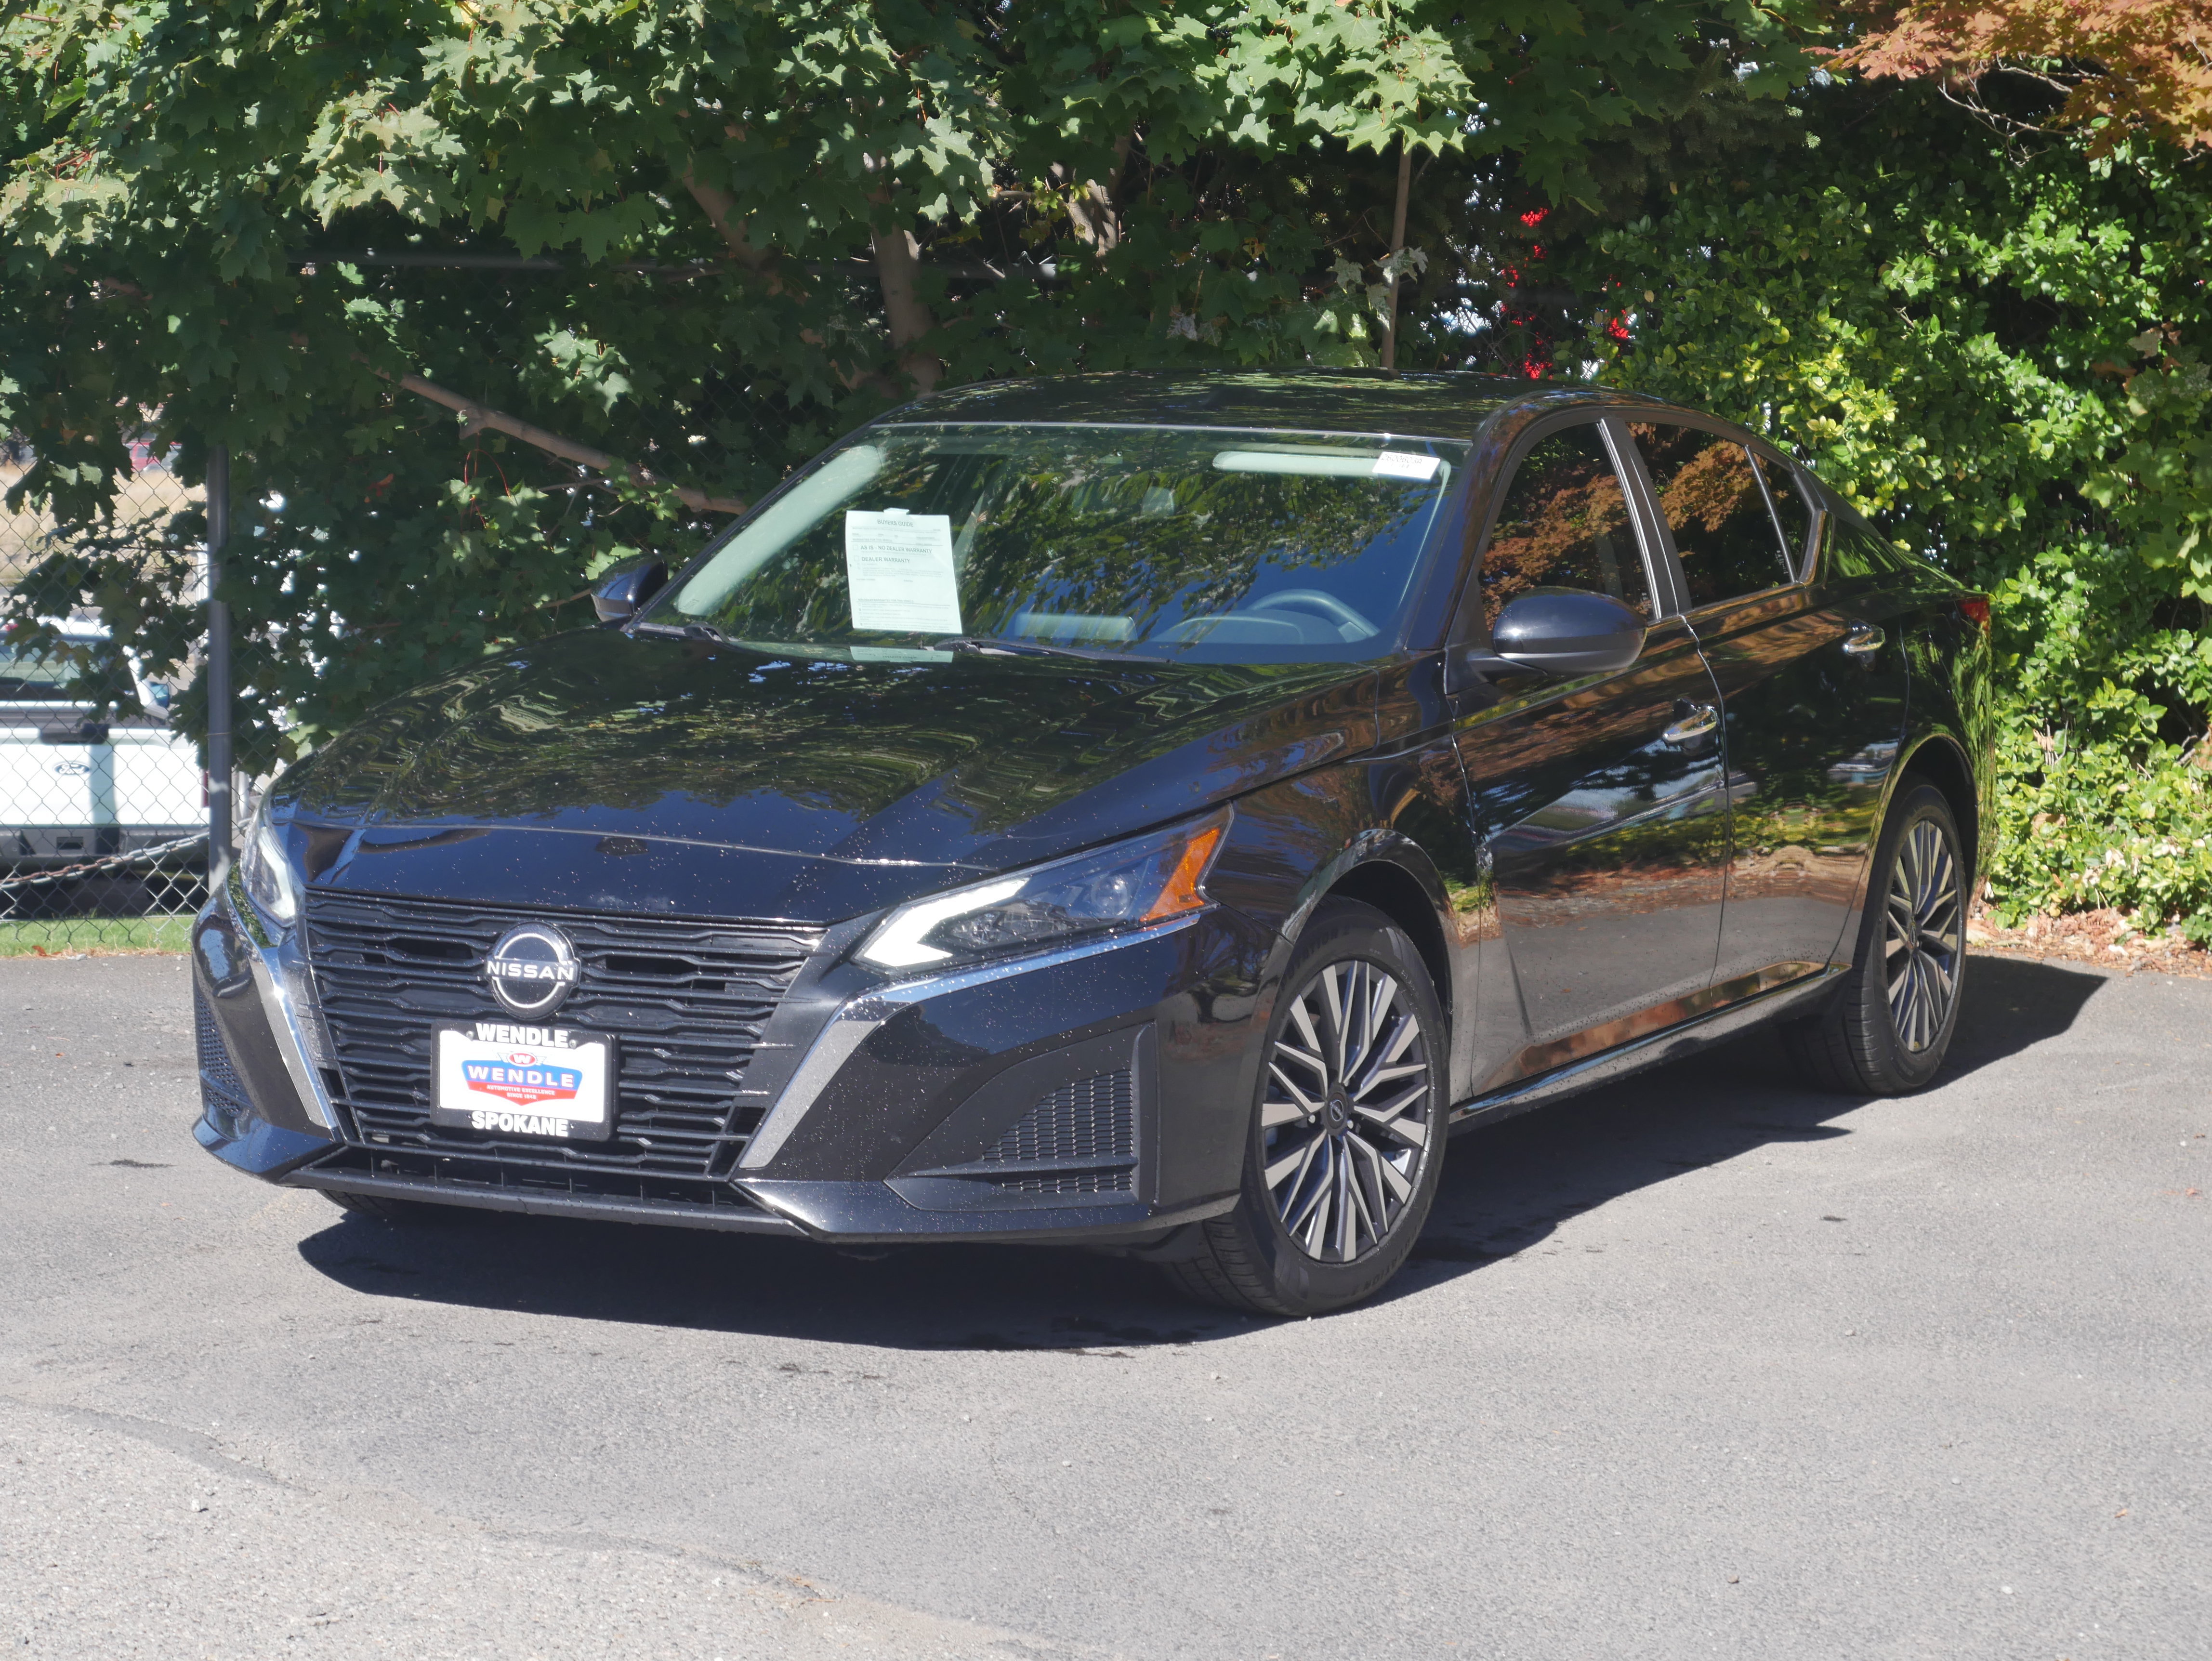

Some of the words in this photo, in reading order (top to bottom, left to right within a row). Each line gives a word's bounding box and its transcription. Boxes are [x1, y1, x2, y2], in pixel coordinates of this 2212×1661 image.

[59, 764, 85, 774] Ford
[487, 960, 574, 981] NISSAN
[476, 1023, 568, 1048] WENDLE
[513, 1055, 531, 1064] W
[467, 1065, 574, 1088] WENDLE
[486, 1084, 521, 1093] AUTOMOTIVE
[522, 1087, 555, 1095] EXCELLENCE
[472, 1110, 568, 1137] SPOKANE
